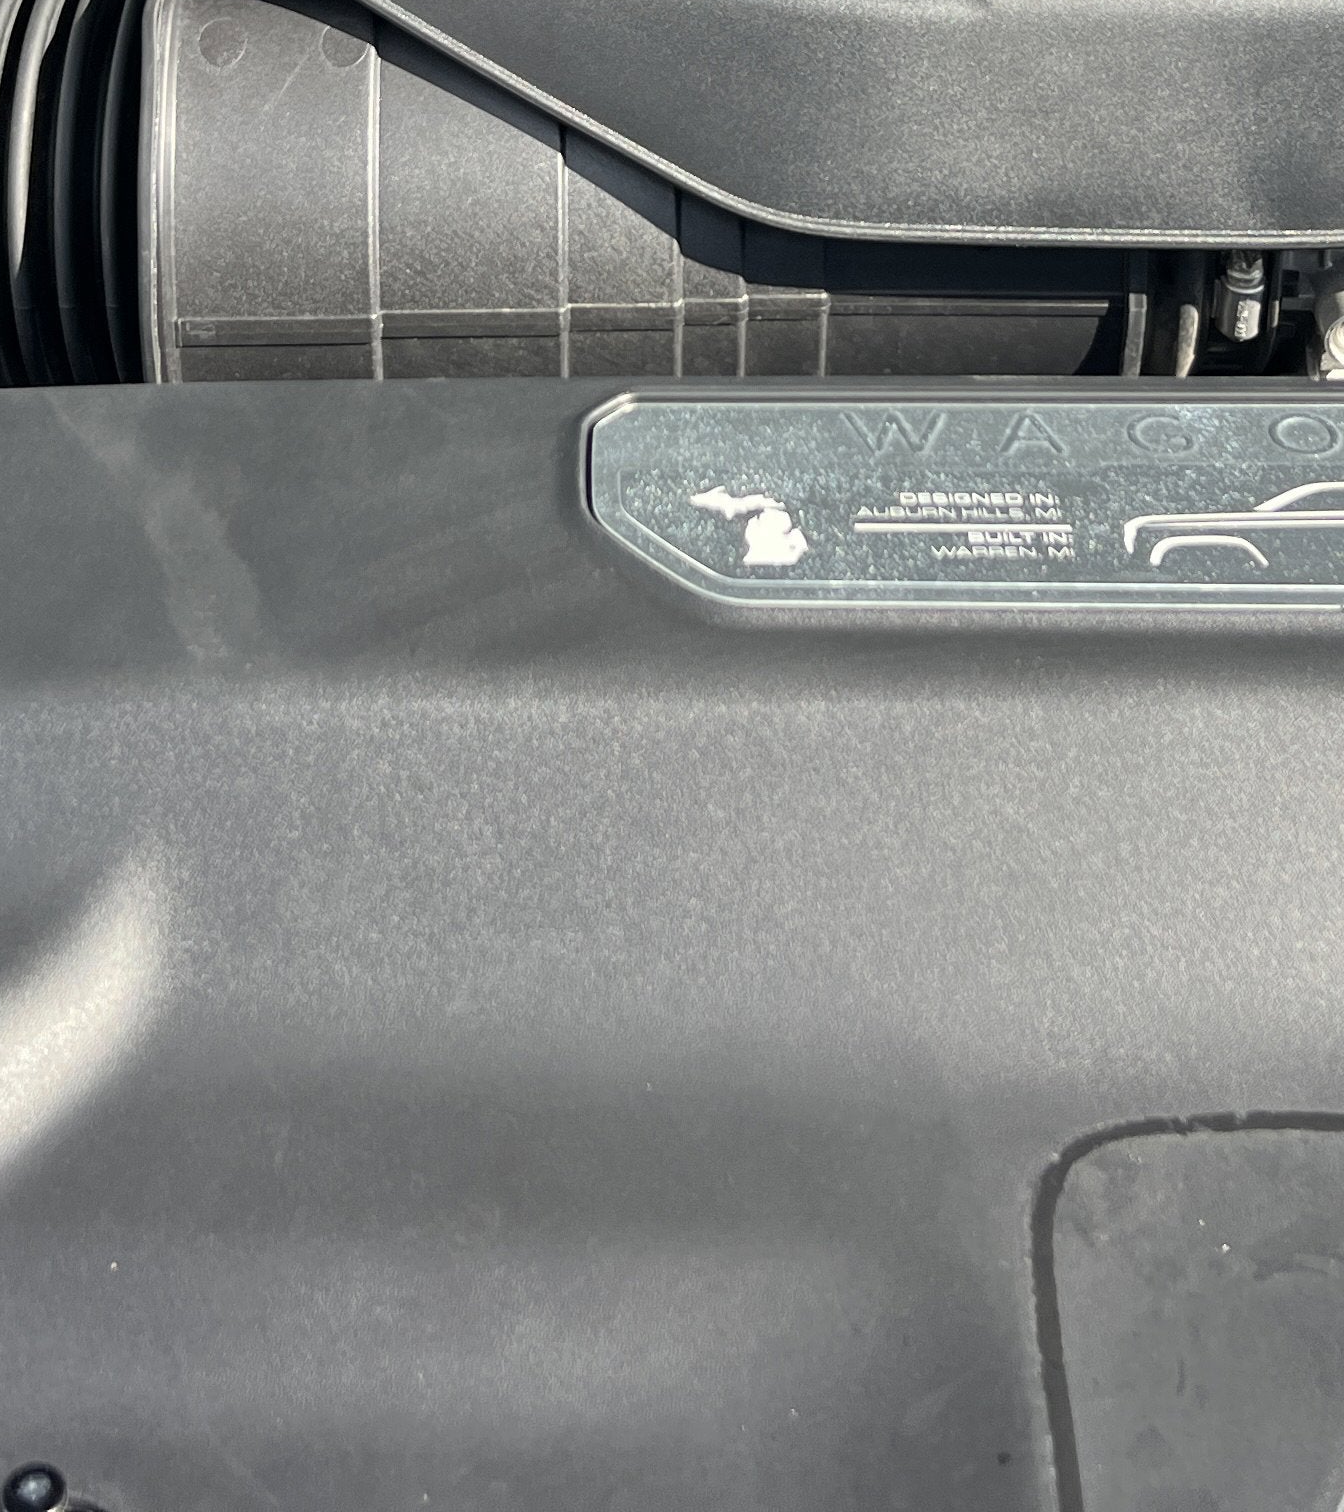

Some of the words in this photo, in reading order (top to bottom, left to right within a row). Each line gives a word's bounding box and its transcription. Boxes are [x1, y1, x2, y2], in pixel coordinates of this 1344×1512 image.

[900, 492, 1024, 507] DESIGNED
[856, 505, 956, 520] AUBURN
[1036, 507, 1062, 522] MI
[968, 531, 1035, 545] BUILT
[1047, 546, 1074, 560] MI
